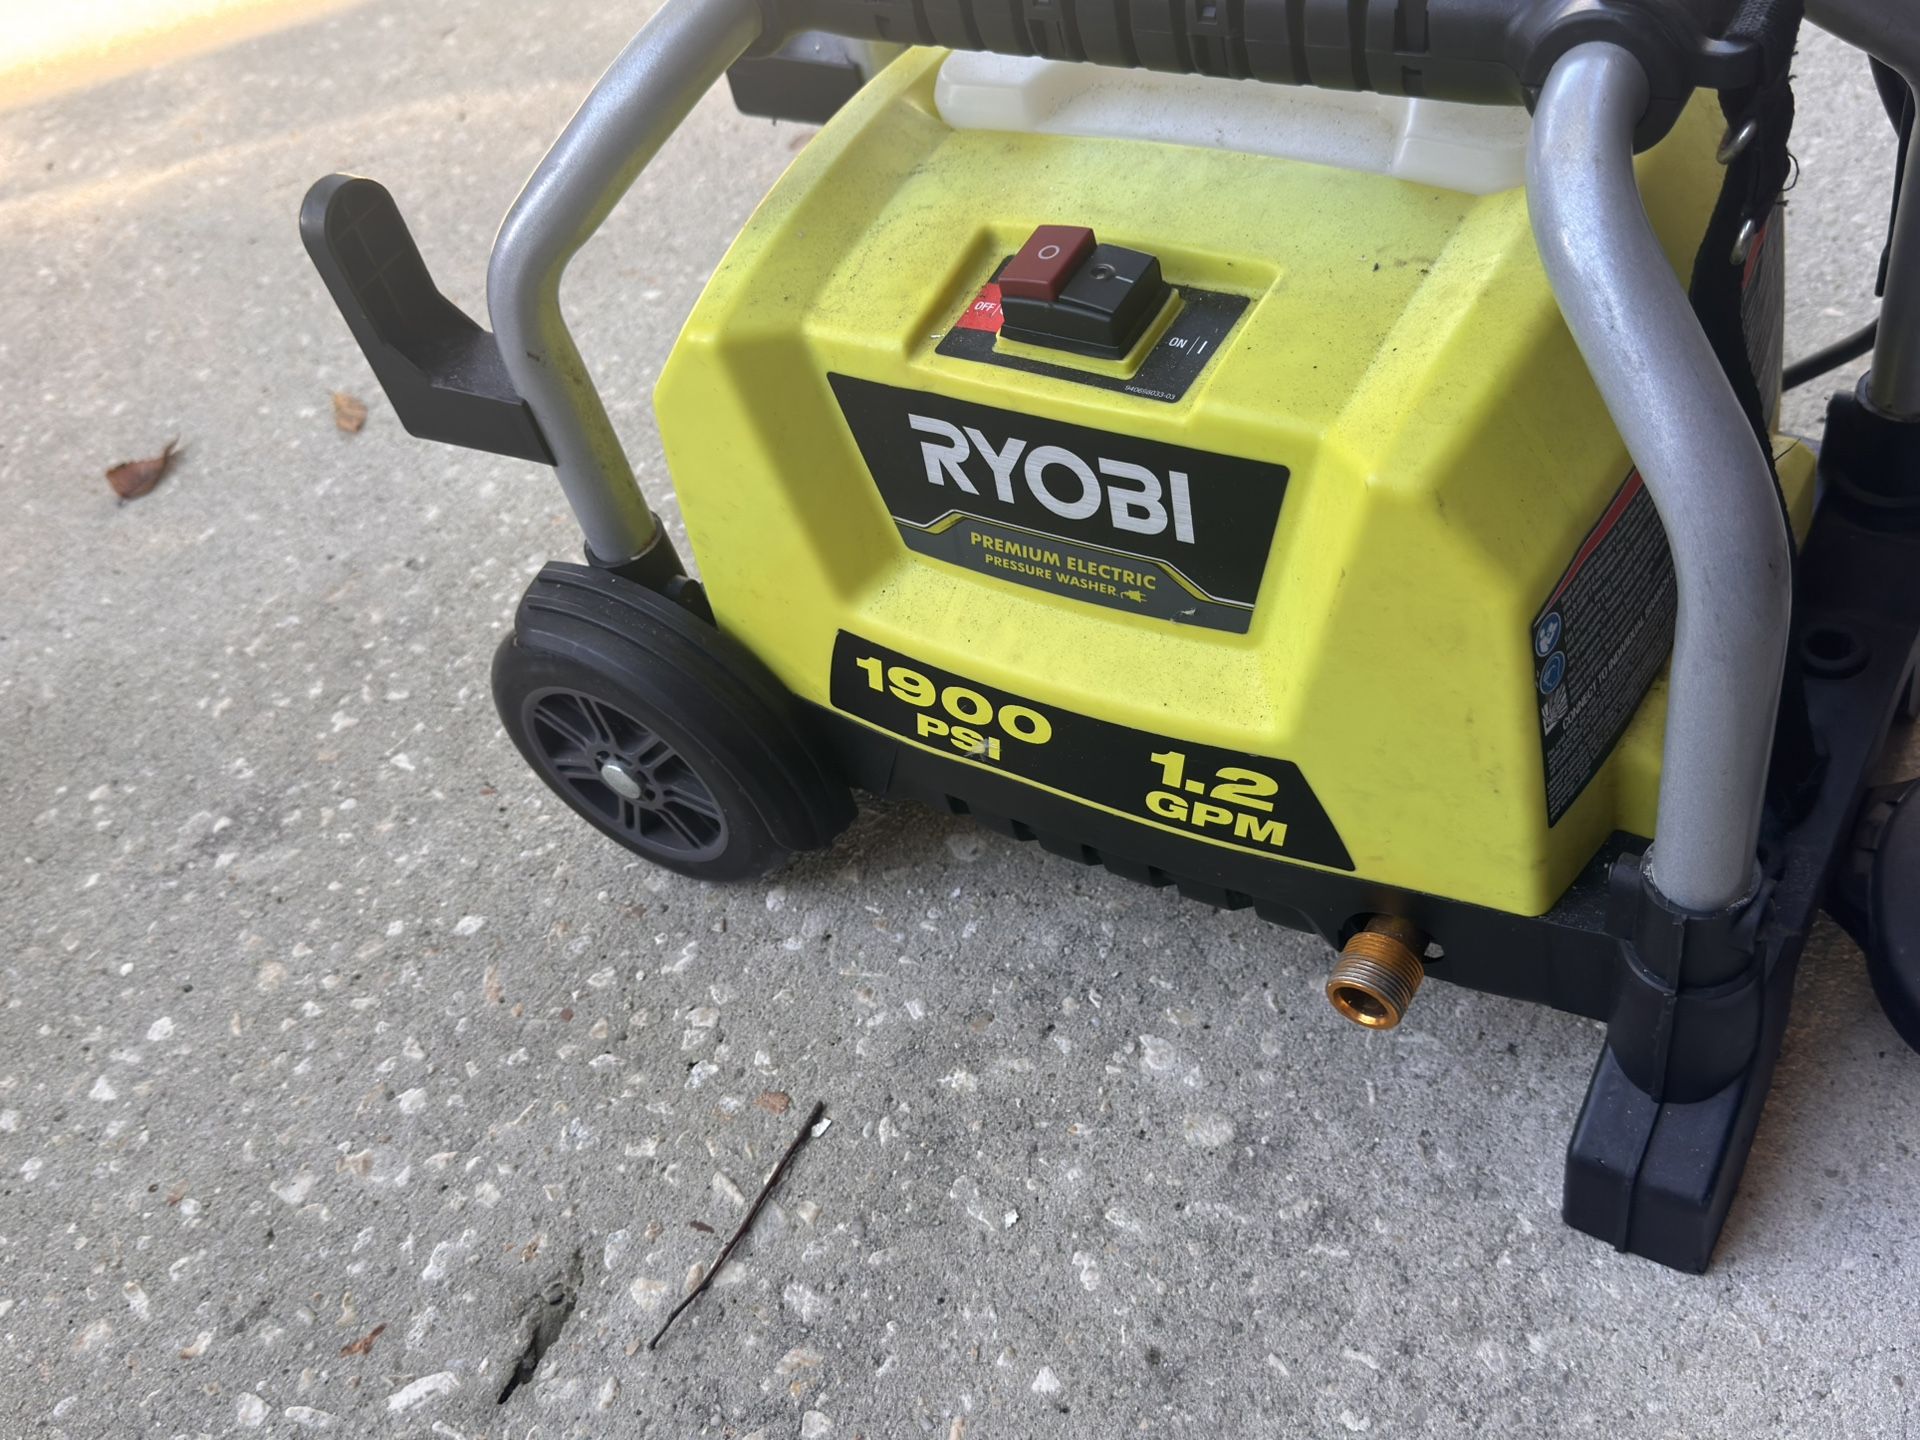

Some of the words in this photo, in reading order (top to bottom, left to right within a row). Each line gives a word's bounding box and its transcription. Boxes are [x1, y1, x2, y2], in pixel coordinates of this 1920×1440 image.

[974, 301, 997, 312] OFF
[1168, 337, 1189, 348] ON
[908, 413, 1195, 544] RYOBI
[970, 531, 1060, 567] PREMIUM
[1066, 555, 1157, 590] ELECTRIC
[984, 552, 1052, 581] PRESSURE
[1056, 572, 1117, 597] WASHER
[856, 657, 1053, 745] 1900
[1562, 681, 1597, 730] CONNECT
[1597, 666, 1608, 684] TO
[916, 713, 1001, 761] PSI
[1150, 750, 1280, 812] 1.2
[1144, 790, 1288, 847] GPM
